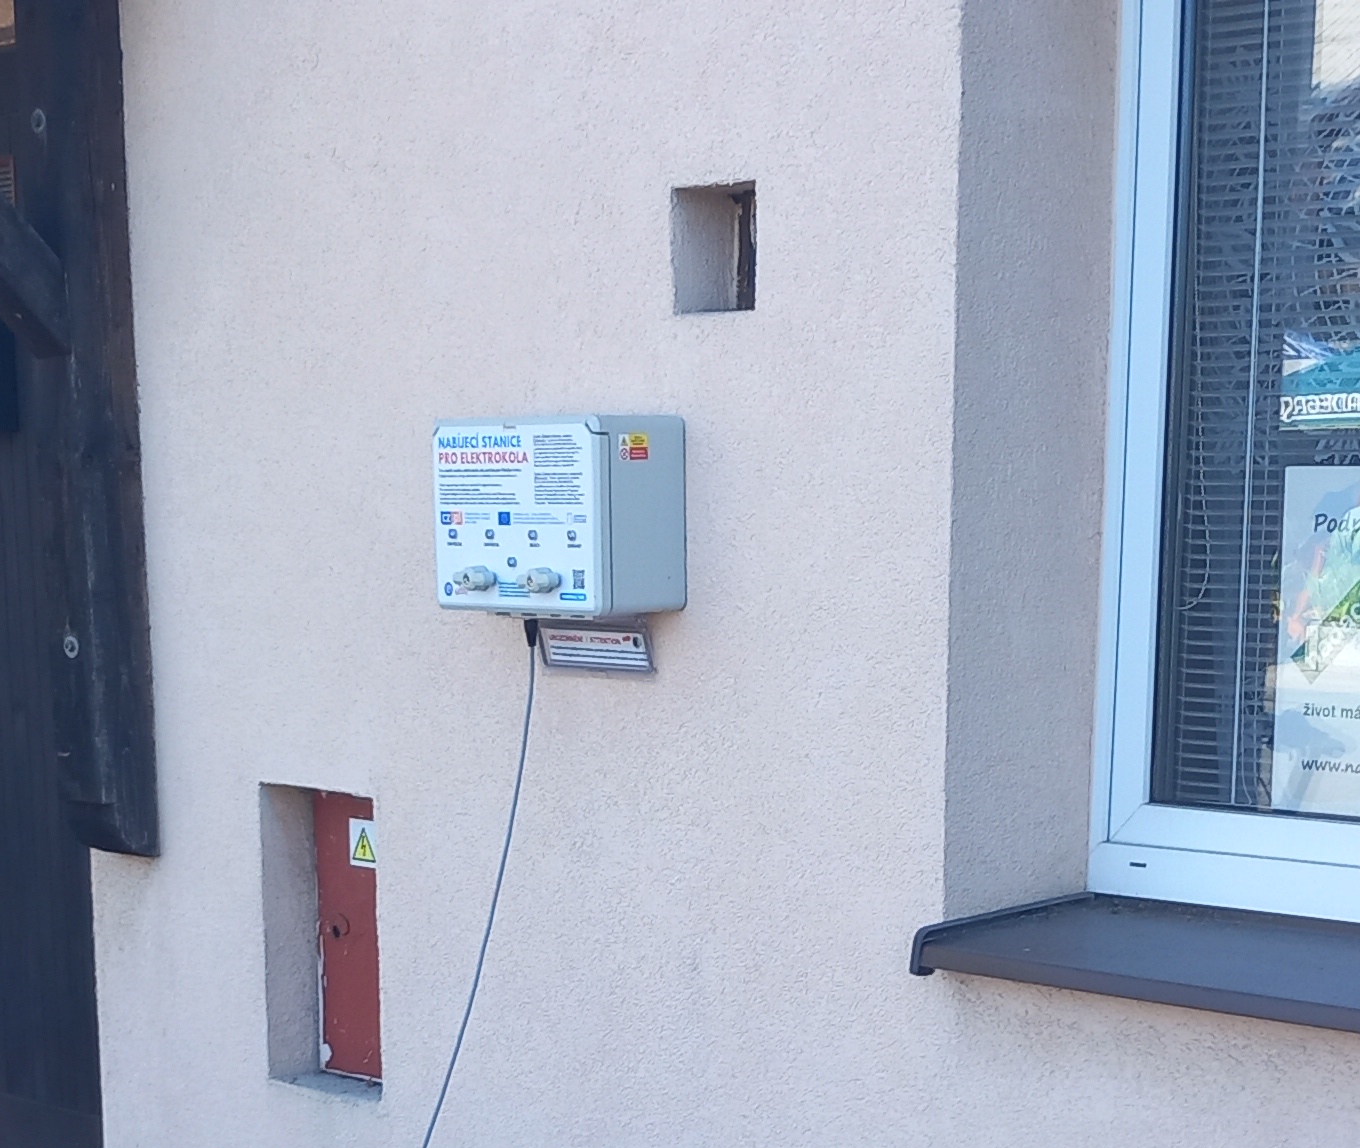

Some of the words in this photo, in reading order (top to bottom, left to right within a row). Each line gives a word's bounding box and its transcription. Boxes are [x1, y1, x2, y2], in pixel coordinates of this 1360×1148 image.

[438, 432, 479, 449] NABÍJECÍ
[481, 435, 522, 449] STANICE
[438, 452, 458, 464] PRO
[460, 451, 529, 465] ELEKTROKOLA
[1302, 702, 1337, 719] život
